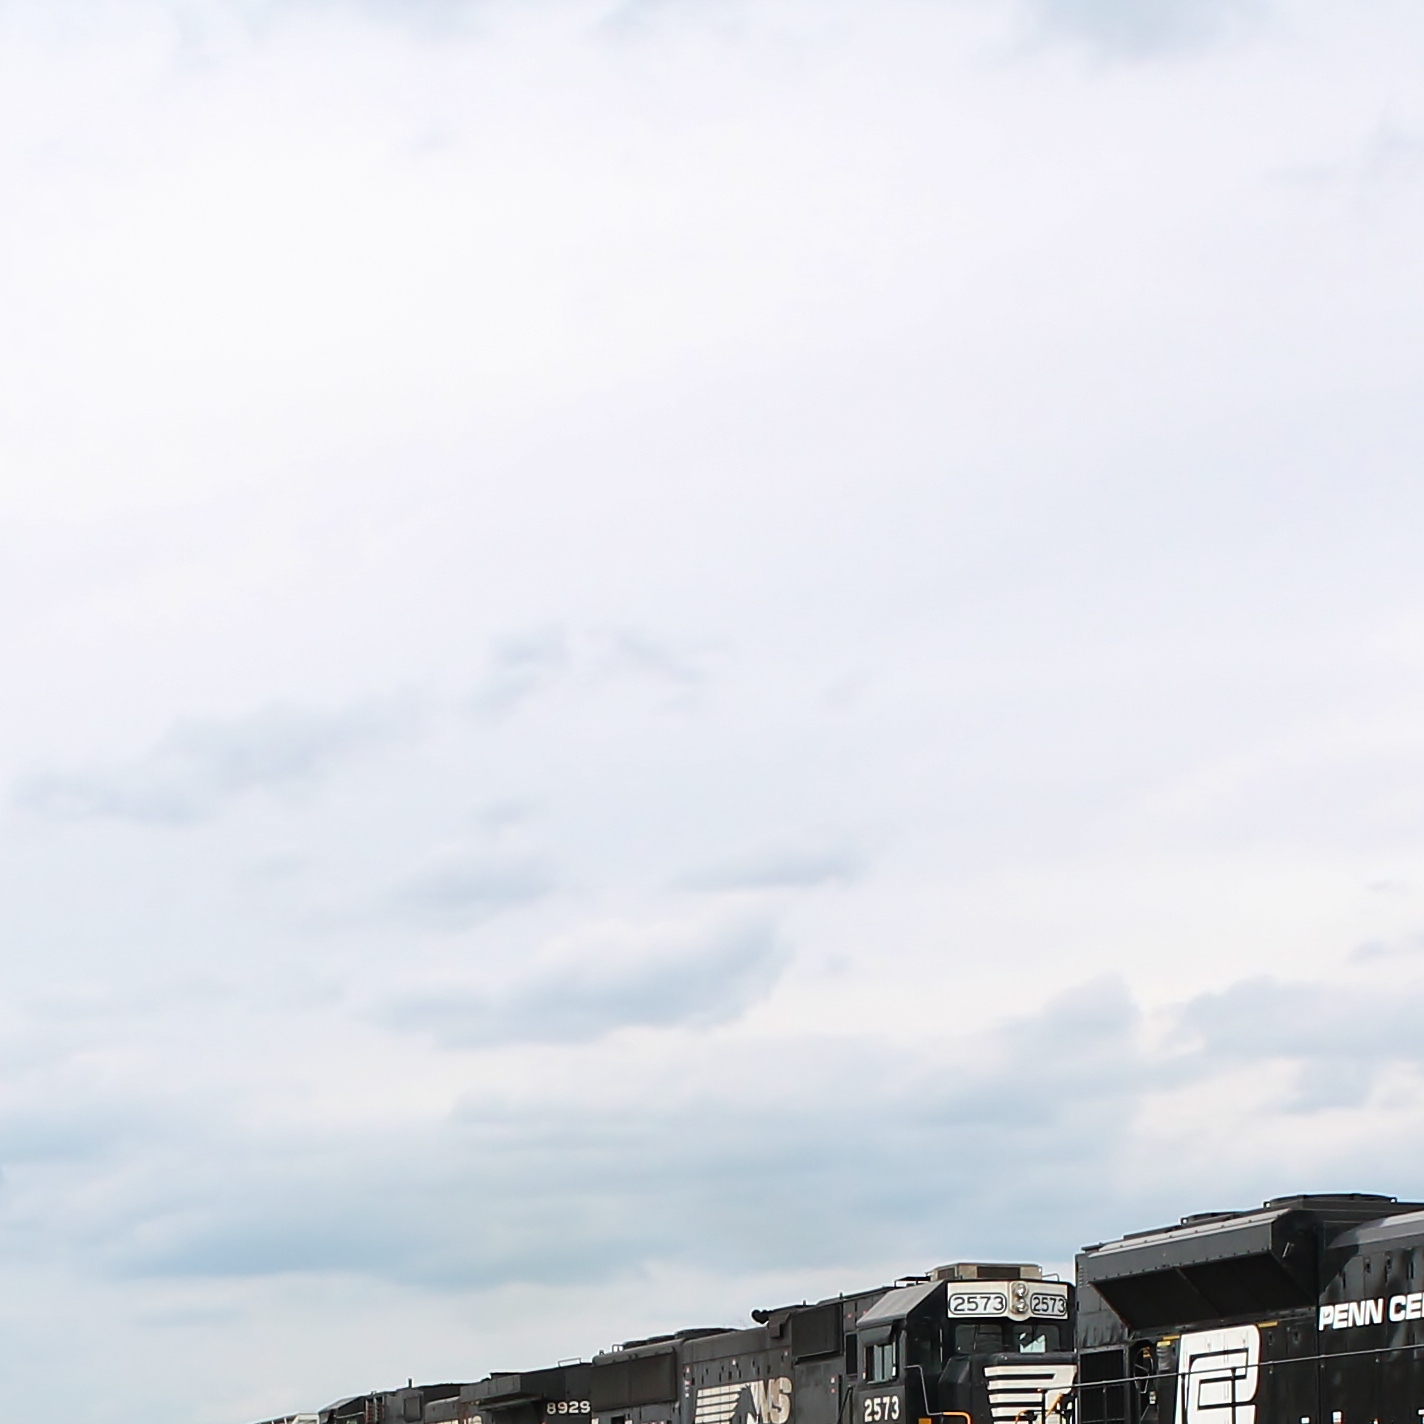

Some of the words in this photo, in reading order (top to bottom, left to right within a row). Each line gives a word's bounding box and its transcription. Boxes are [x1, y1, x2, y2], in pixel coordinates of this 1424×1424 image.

[953, 1296, 1005, 1312] 2573
[1033, 1296, 1066, 1313] 2573
[1318, 1298, 1384, 1331] PENN
[547, 1401, 591, 1415] 8929
[864, 1395, 900, 1423] 2573
